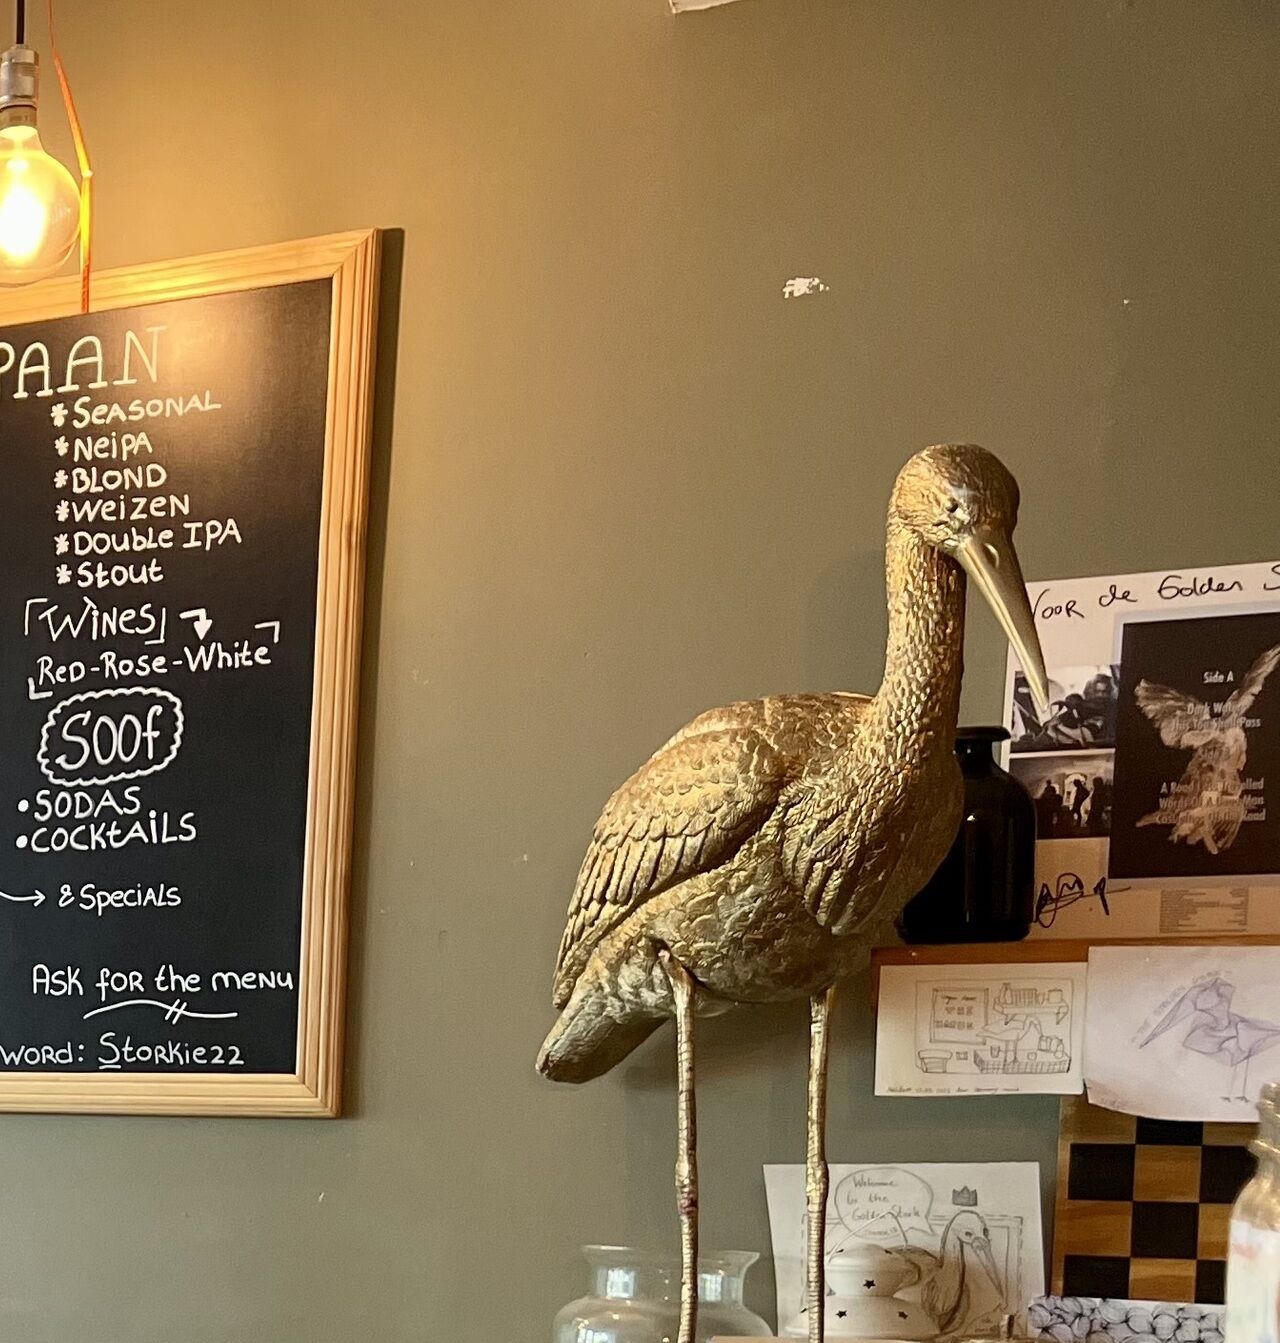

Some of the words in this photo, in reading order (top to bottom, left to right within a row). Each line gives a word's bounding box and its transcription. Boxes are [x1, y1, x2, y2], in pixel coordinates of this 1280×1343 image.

[182, 518, 242, 551] IPA
[77, 558, 164, 588] Stout
[1098, 584, 1138, 607] de
[1158, 575, 1243, 600] Golden
[1203, 671, 1224, 684] Side
[1226, 670, 1234, 682] A
[34, 786, 141, 821] SODAS
[155, 964, 201, 992] the
